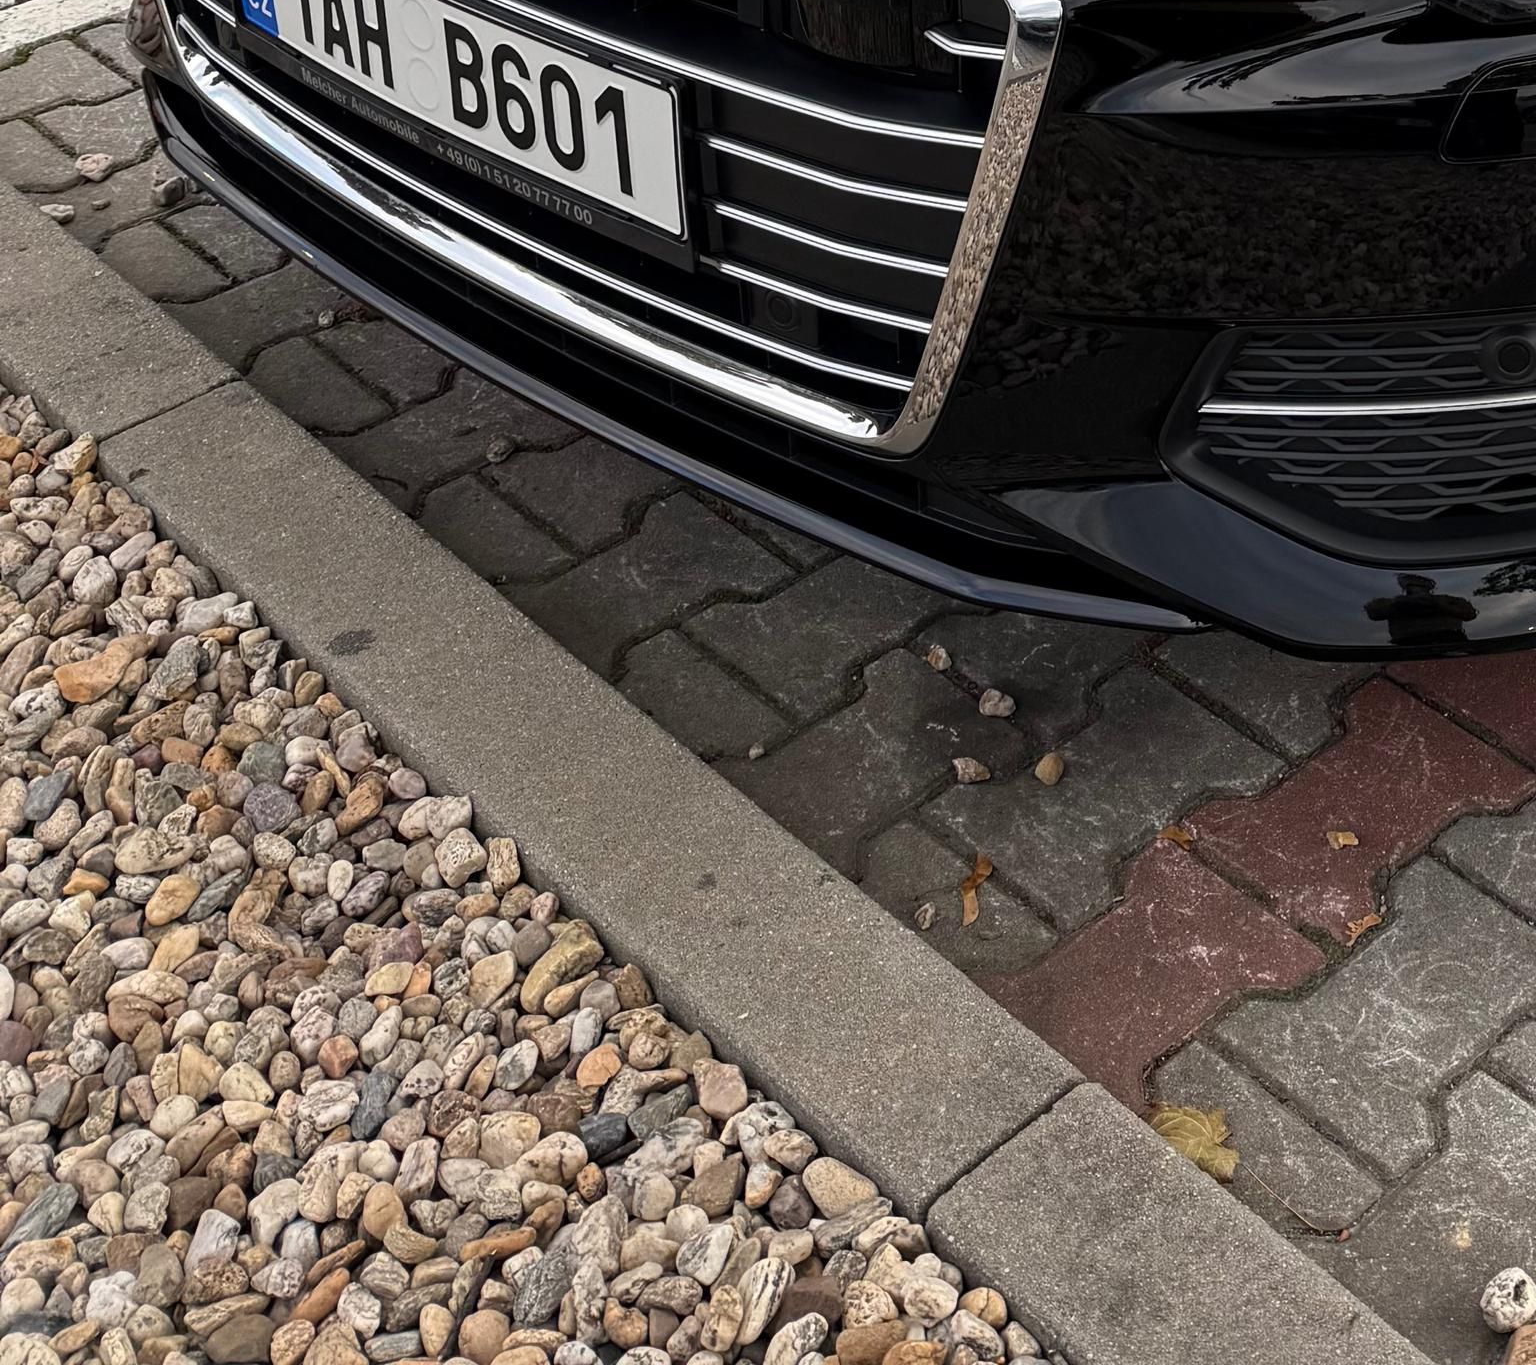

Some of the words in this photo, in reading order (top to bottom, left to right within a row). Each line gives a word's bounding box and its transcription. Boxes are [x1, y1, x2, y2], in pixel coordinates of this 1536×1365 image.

[301, 66, 347, 105] Melcher
[351, 95, 420, 144] Automobile
[442, 17, 634, 198] B601
